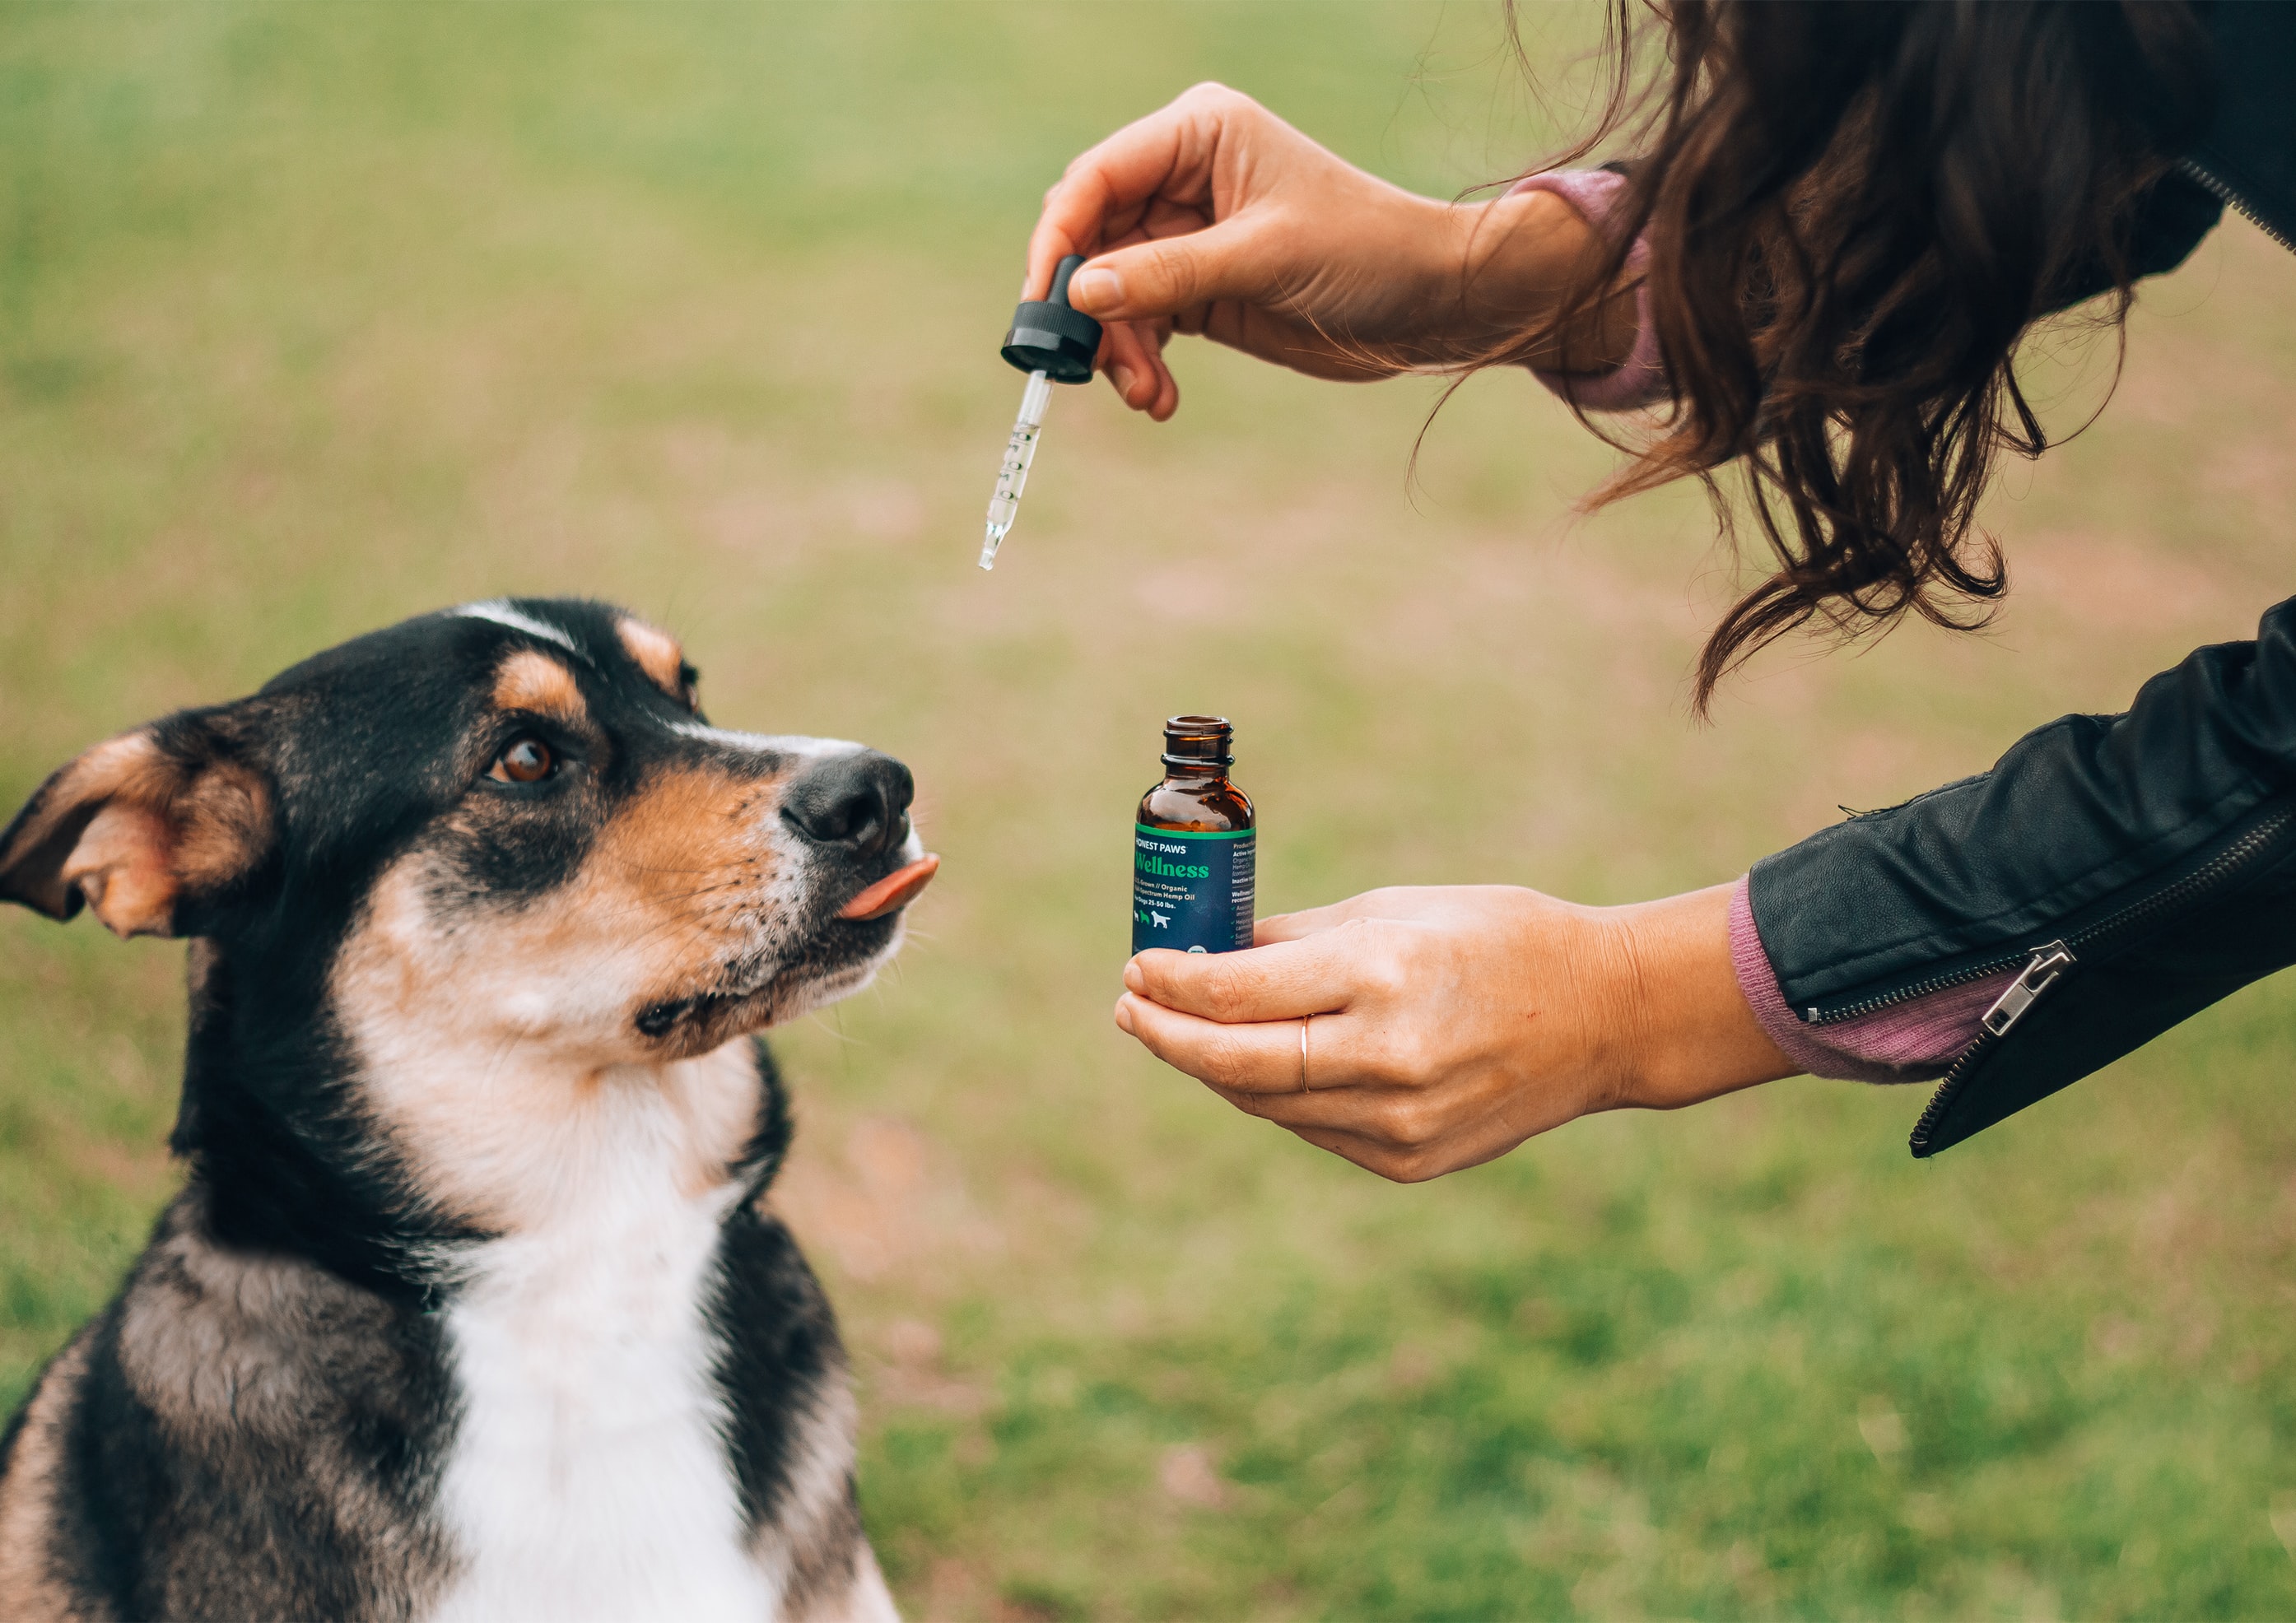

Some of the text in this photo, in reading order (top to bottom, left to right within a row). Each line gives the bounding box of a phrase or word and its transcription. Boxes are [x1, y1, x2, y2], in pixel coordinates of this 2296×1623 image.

[1160, 844, 1186, 854] PAWS
[1136, 852, 1209, 878] Wellness
[1161, 884, 1188, 892] Organic
[1163, 892, 1183, 901] Hemp
